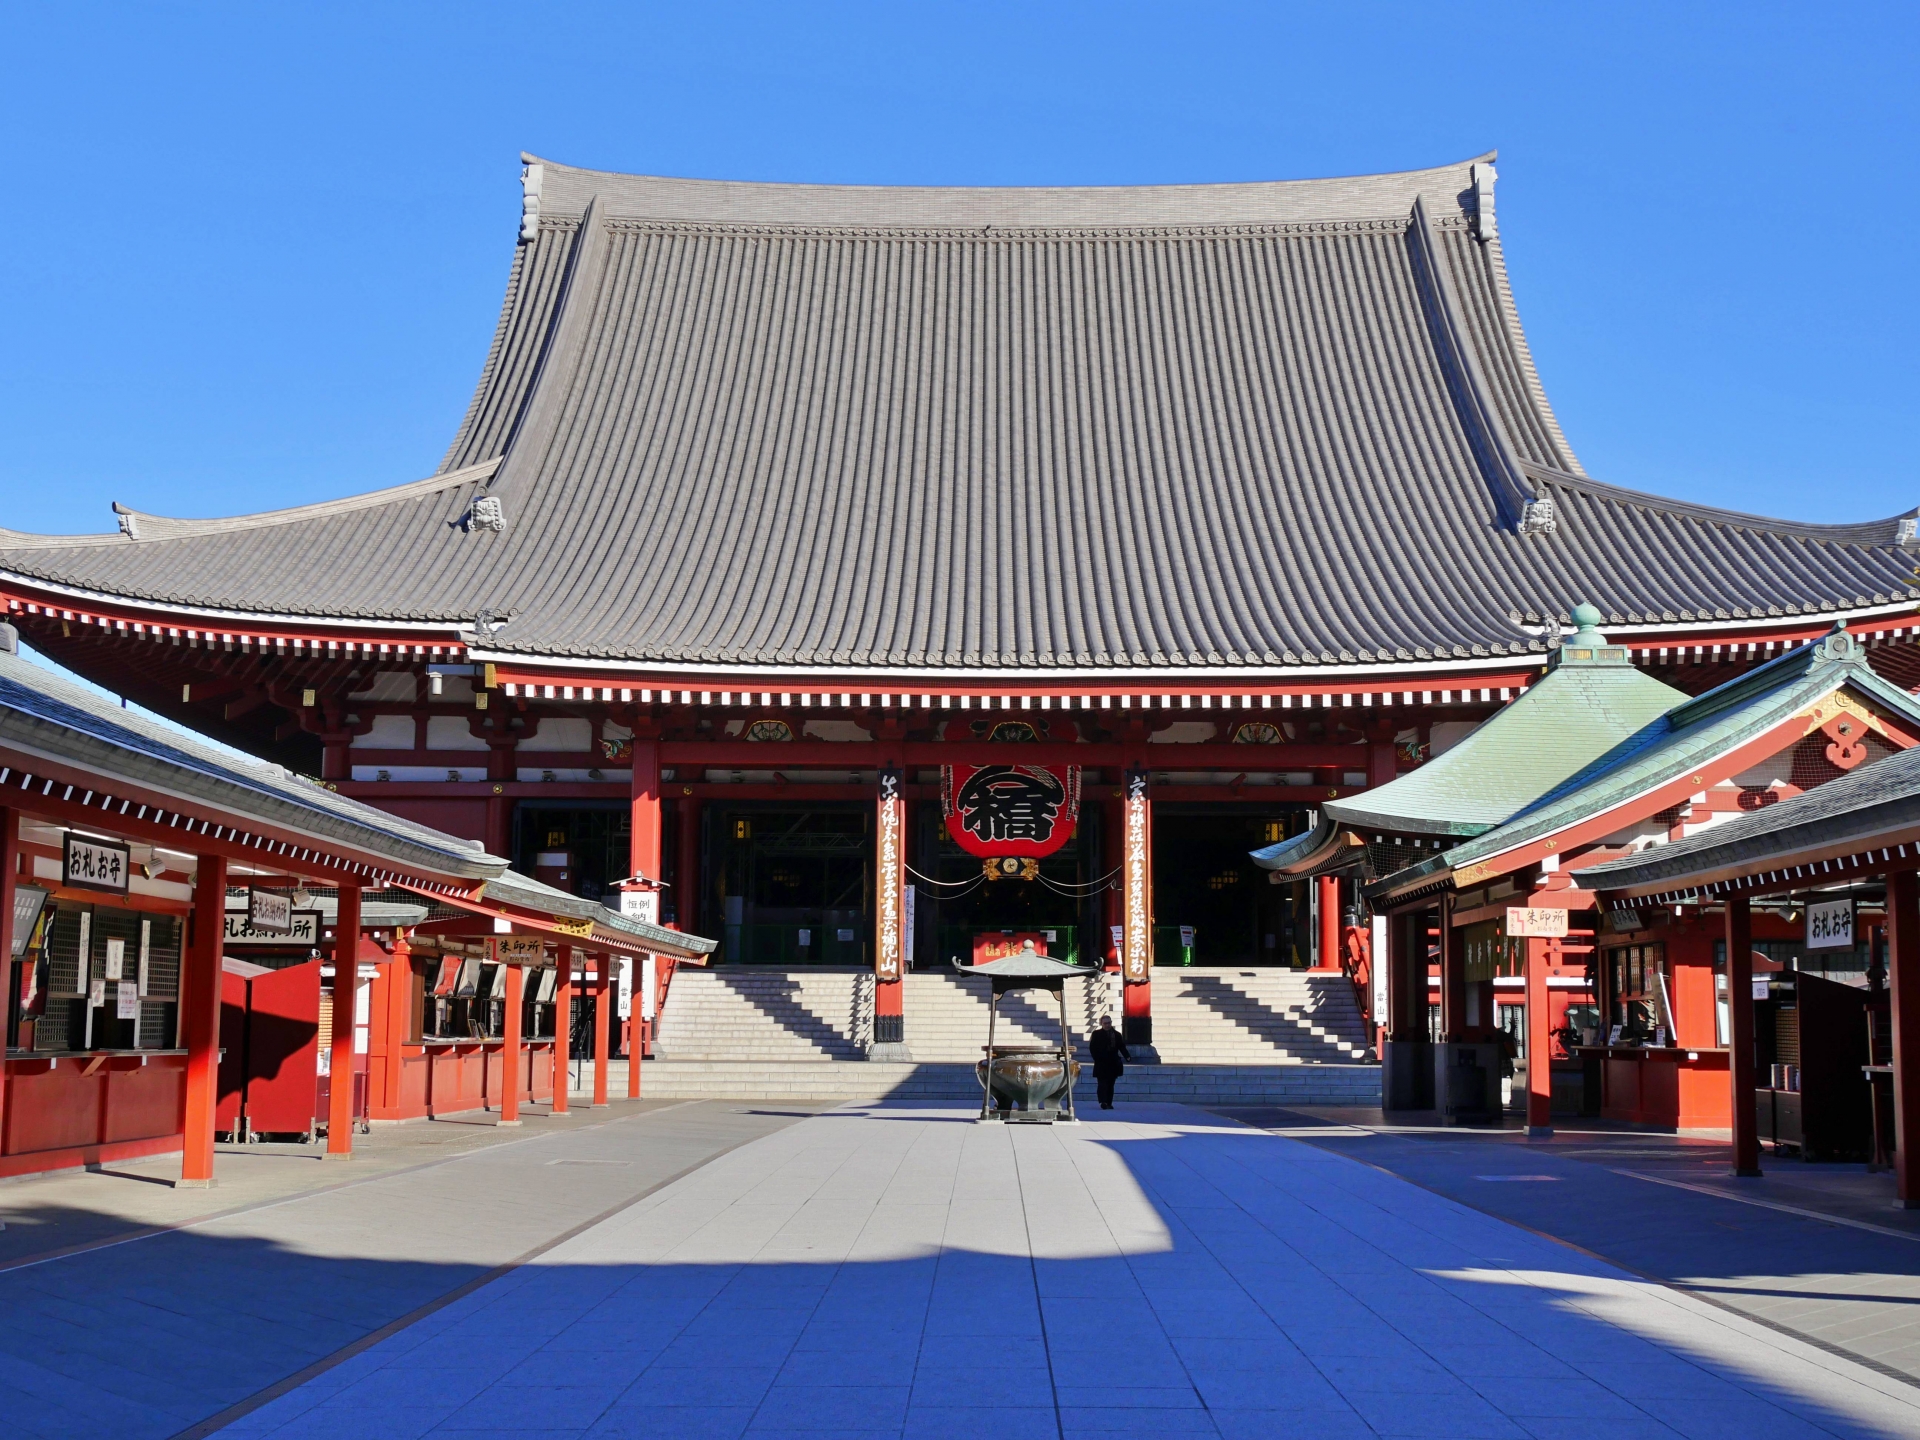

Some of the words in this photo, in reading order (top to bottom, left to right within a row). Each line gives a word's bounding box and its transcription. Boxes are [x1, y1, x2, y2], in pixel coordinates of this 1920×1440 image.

[70, 845, 121, 884] お札お守
[627, 899, 650, 910] 恒例
[1526, 909, 1565, 926] 朱印所
[1812, 907, 1851, 939] お札お守
[499, 939, 541, 955] 朱印所
